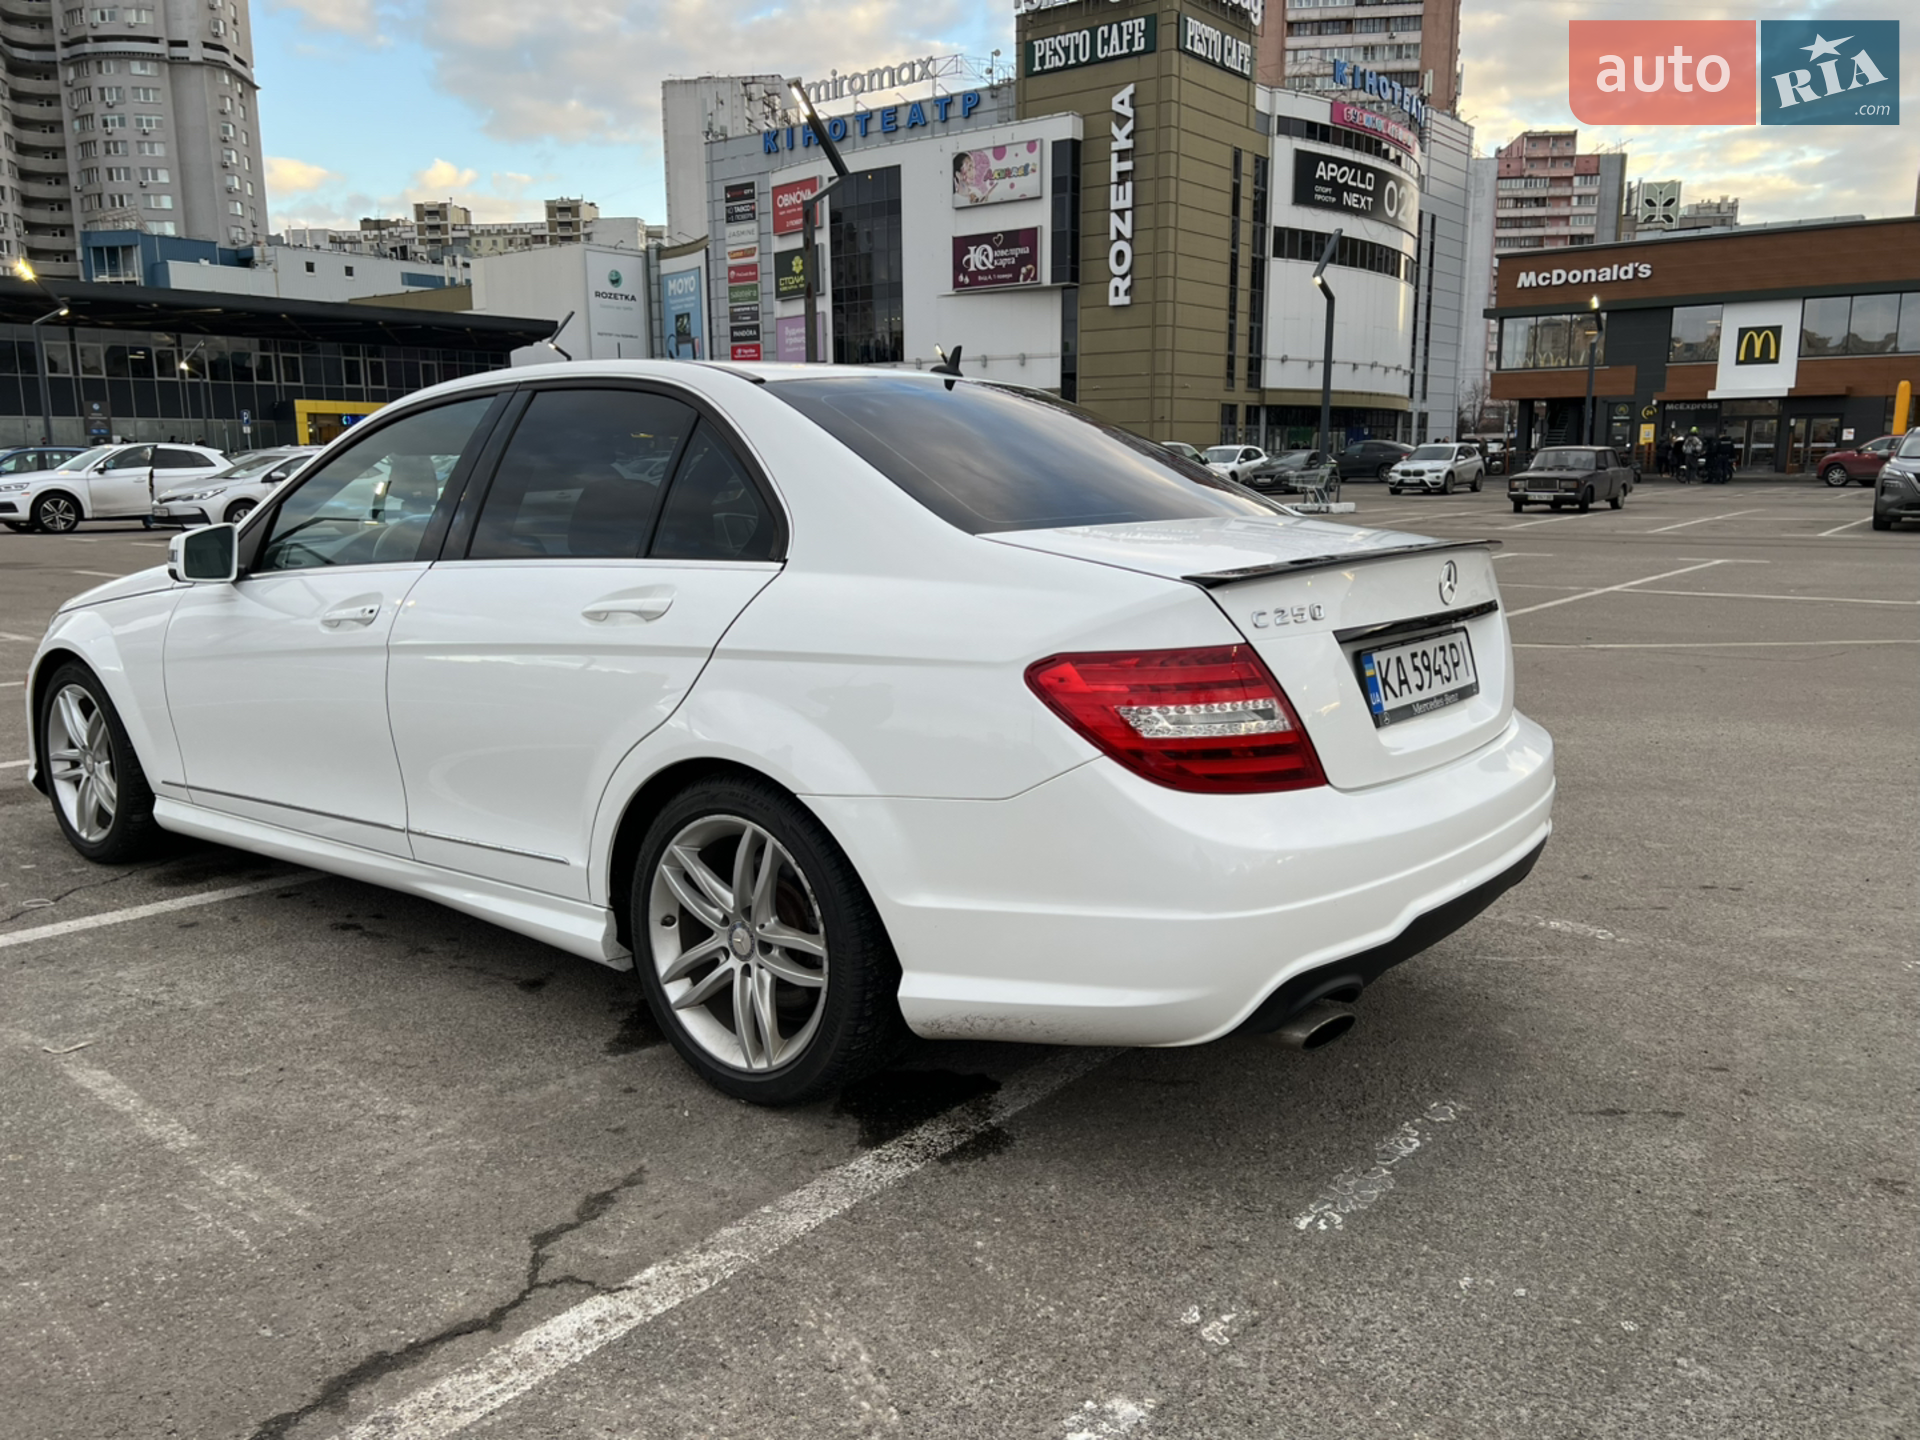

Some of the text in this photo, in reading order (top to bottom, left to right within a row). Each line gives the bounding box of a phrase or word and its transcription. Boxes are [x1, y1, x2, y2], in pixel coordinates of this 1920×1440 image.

[1033, 17, 1146, 72] PESTO CAFE
[1185, 17, 1251, 75] PESTO CAFE
[804, 56, 934, 103] miromax
[763, 90, 980, 154] КІНОТЕАТР
[1315, 161, 1375, 191] APOLLO
[1108, 83, 1135, 306] ROZETKA
[1343, 191, 1373, 211] NEXT
[728, 228, 756, 239] JASMINE
[668, 275, 696, 296] MOYO
[1516, 262, 1652, 288] McDonald's
[594, 291, 637, 302] ROZETKA
[1665, 402, 1719, 411] McExpress
